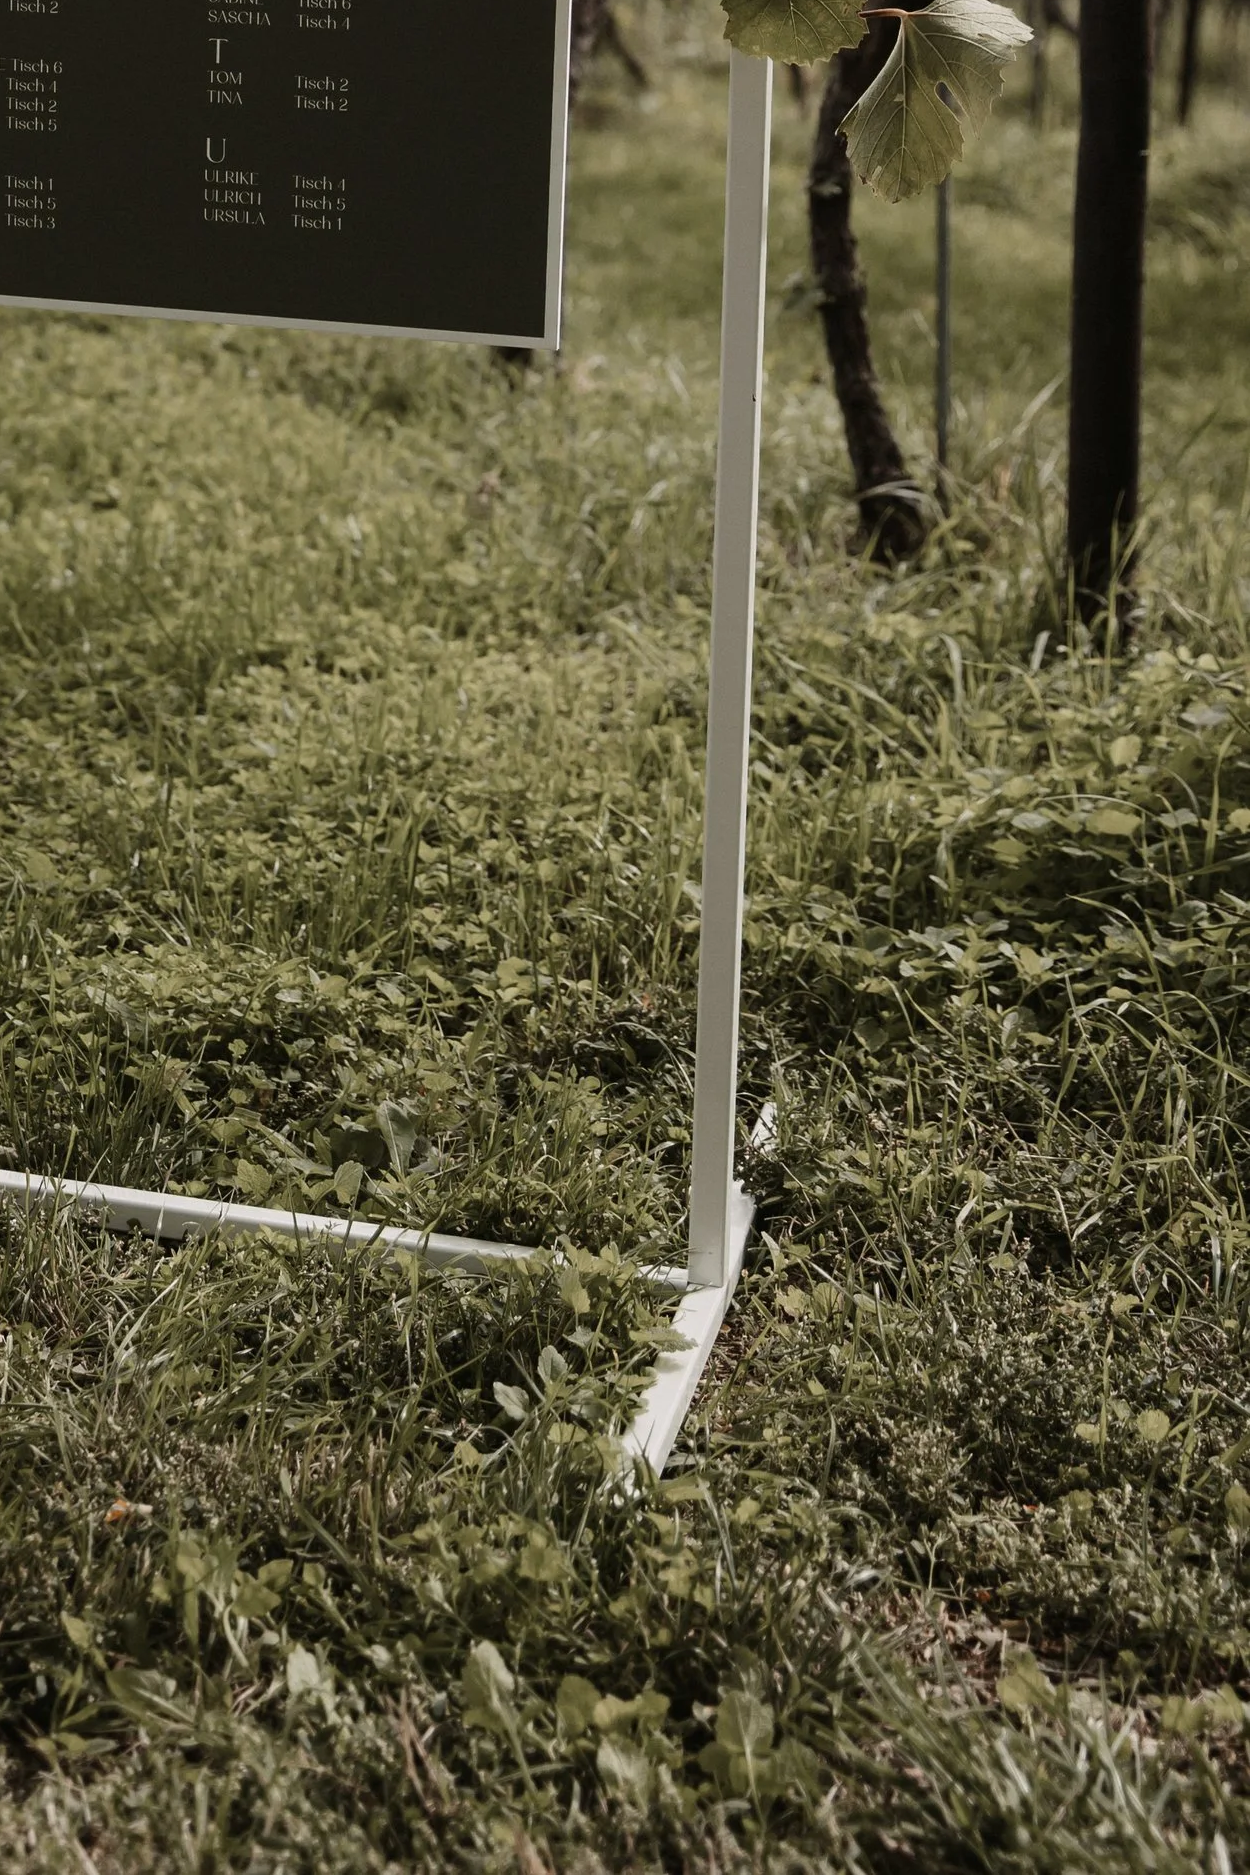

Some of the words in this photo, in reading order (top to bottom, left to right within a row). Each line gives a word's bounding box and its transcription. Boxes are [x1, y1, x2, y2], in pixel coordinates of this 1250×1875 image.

[49, 1, 59, 14] 2
[208, 9, 270, 25] SASCHA
[297, 14, 338, 29] Tisch
[341, 17, 350, 30] 4
[209, 38, 228, 64] T
[11, 58, 49, 73] Tisch
[53, 61, 62, 74] 6
[6, 77, 45, 93] Tisch
[48, 80, 57, 93] 4
[207, 70, 242, 85] TOM
[295, 75, 335, 91] Tisch
[339, 79, 348, 91] 2
[6, 97, 45, 112] Tisch
[48, 100, 57, 113] 2
[207, 90, 243, 105] TINA
[294, 95, 334, 111] Tisch
[339, 98, 348, 111] 2
[6, 116, 45, 131] Tisch
[48, 119, 57, 132] 5
[206, 137, 226, 163] U
[5, 175, 43, 190] Tisch
[49, 178, 54, 190] 1
[204, 169, 258, 186] ULRIKE
[293, 175, 333, 191] Tisch
[337, 178, 346, 191] 4
[5, 195, 43, 209] Tisch
[47, 198, 56, 210] 5
[204, 189, 261, 205] ULRICH
[293, 195, 332, 211] Tisch
[336, 198, 346, 211] 5
[5, 213, 43, 228] Tisch
[46, 216, 55, 229] 3
[204, 208, 265, 225] URSULA
[292, 214, 332, 230] Tisch
[338, 217, 342, 230] 1
